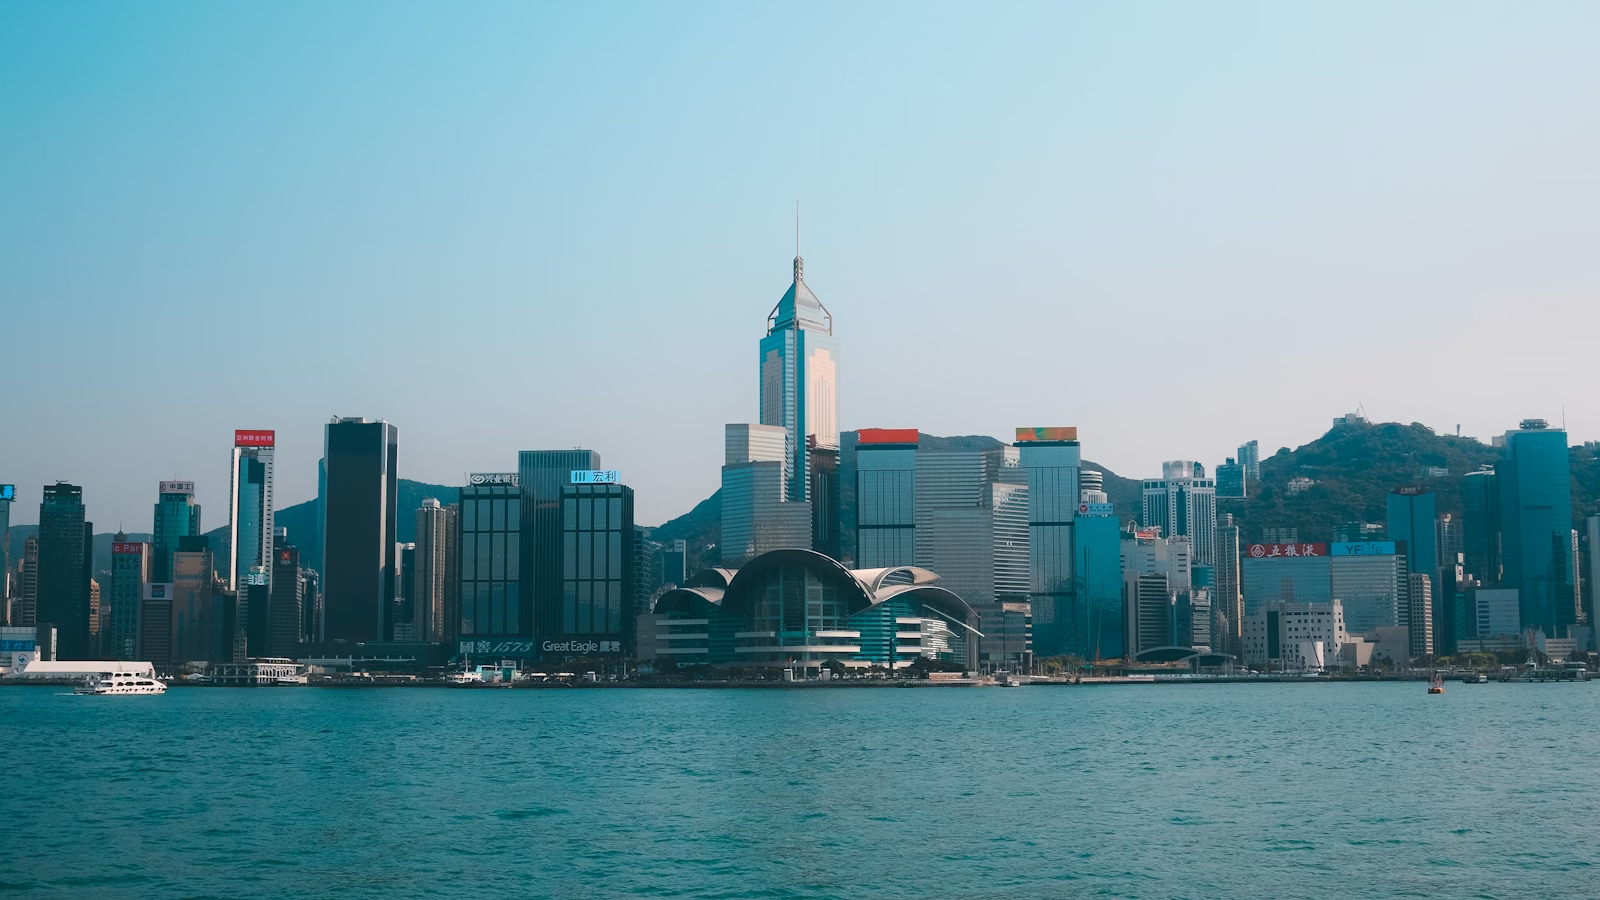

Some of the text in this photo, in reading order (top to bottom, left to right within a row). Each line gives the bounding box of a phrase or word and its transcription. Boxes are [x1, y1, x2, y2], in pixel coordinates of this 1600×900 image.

[485, 475, 519, 485] 兴业银行
[592, 471, 615, 482] 宏利
[542, 640, 620, 653] Great Eagle 鷹君
